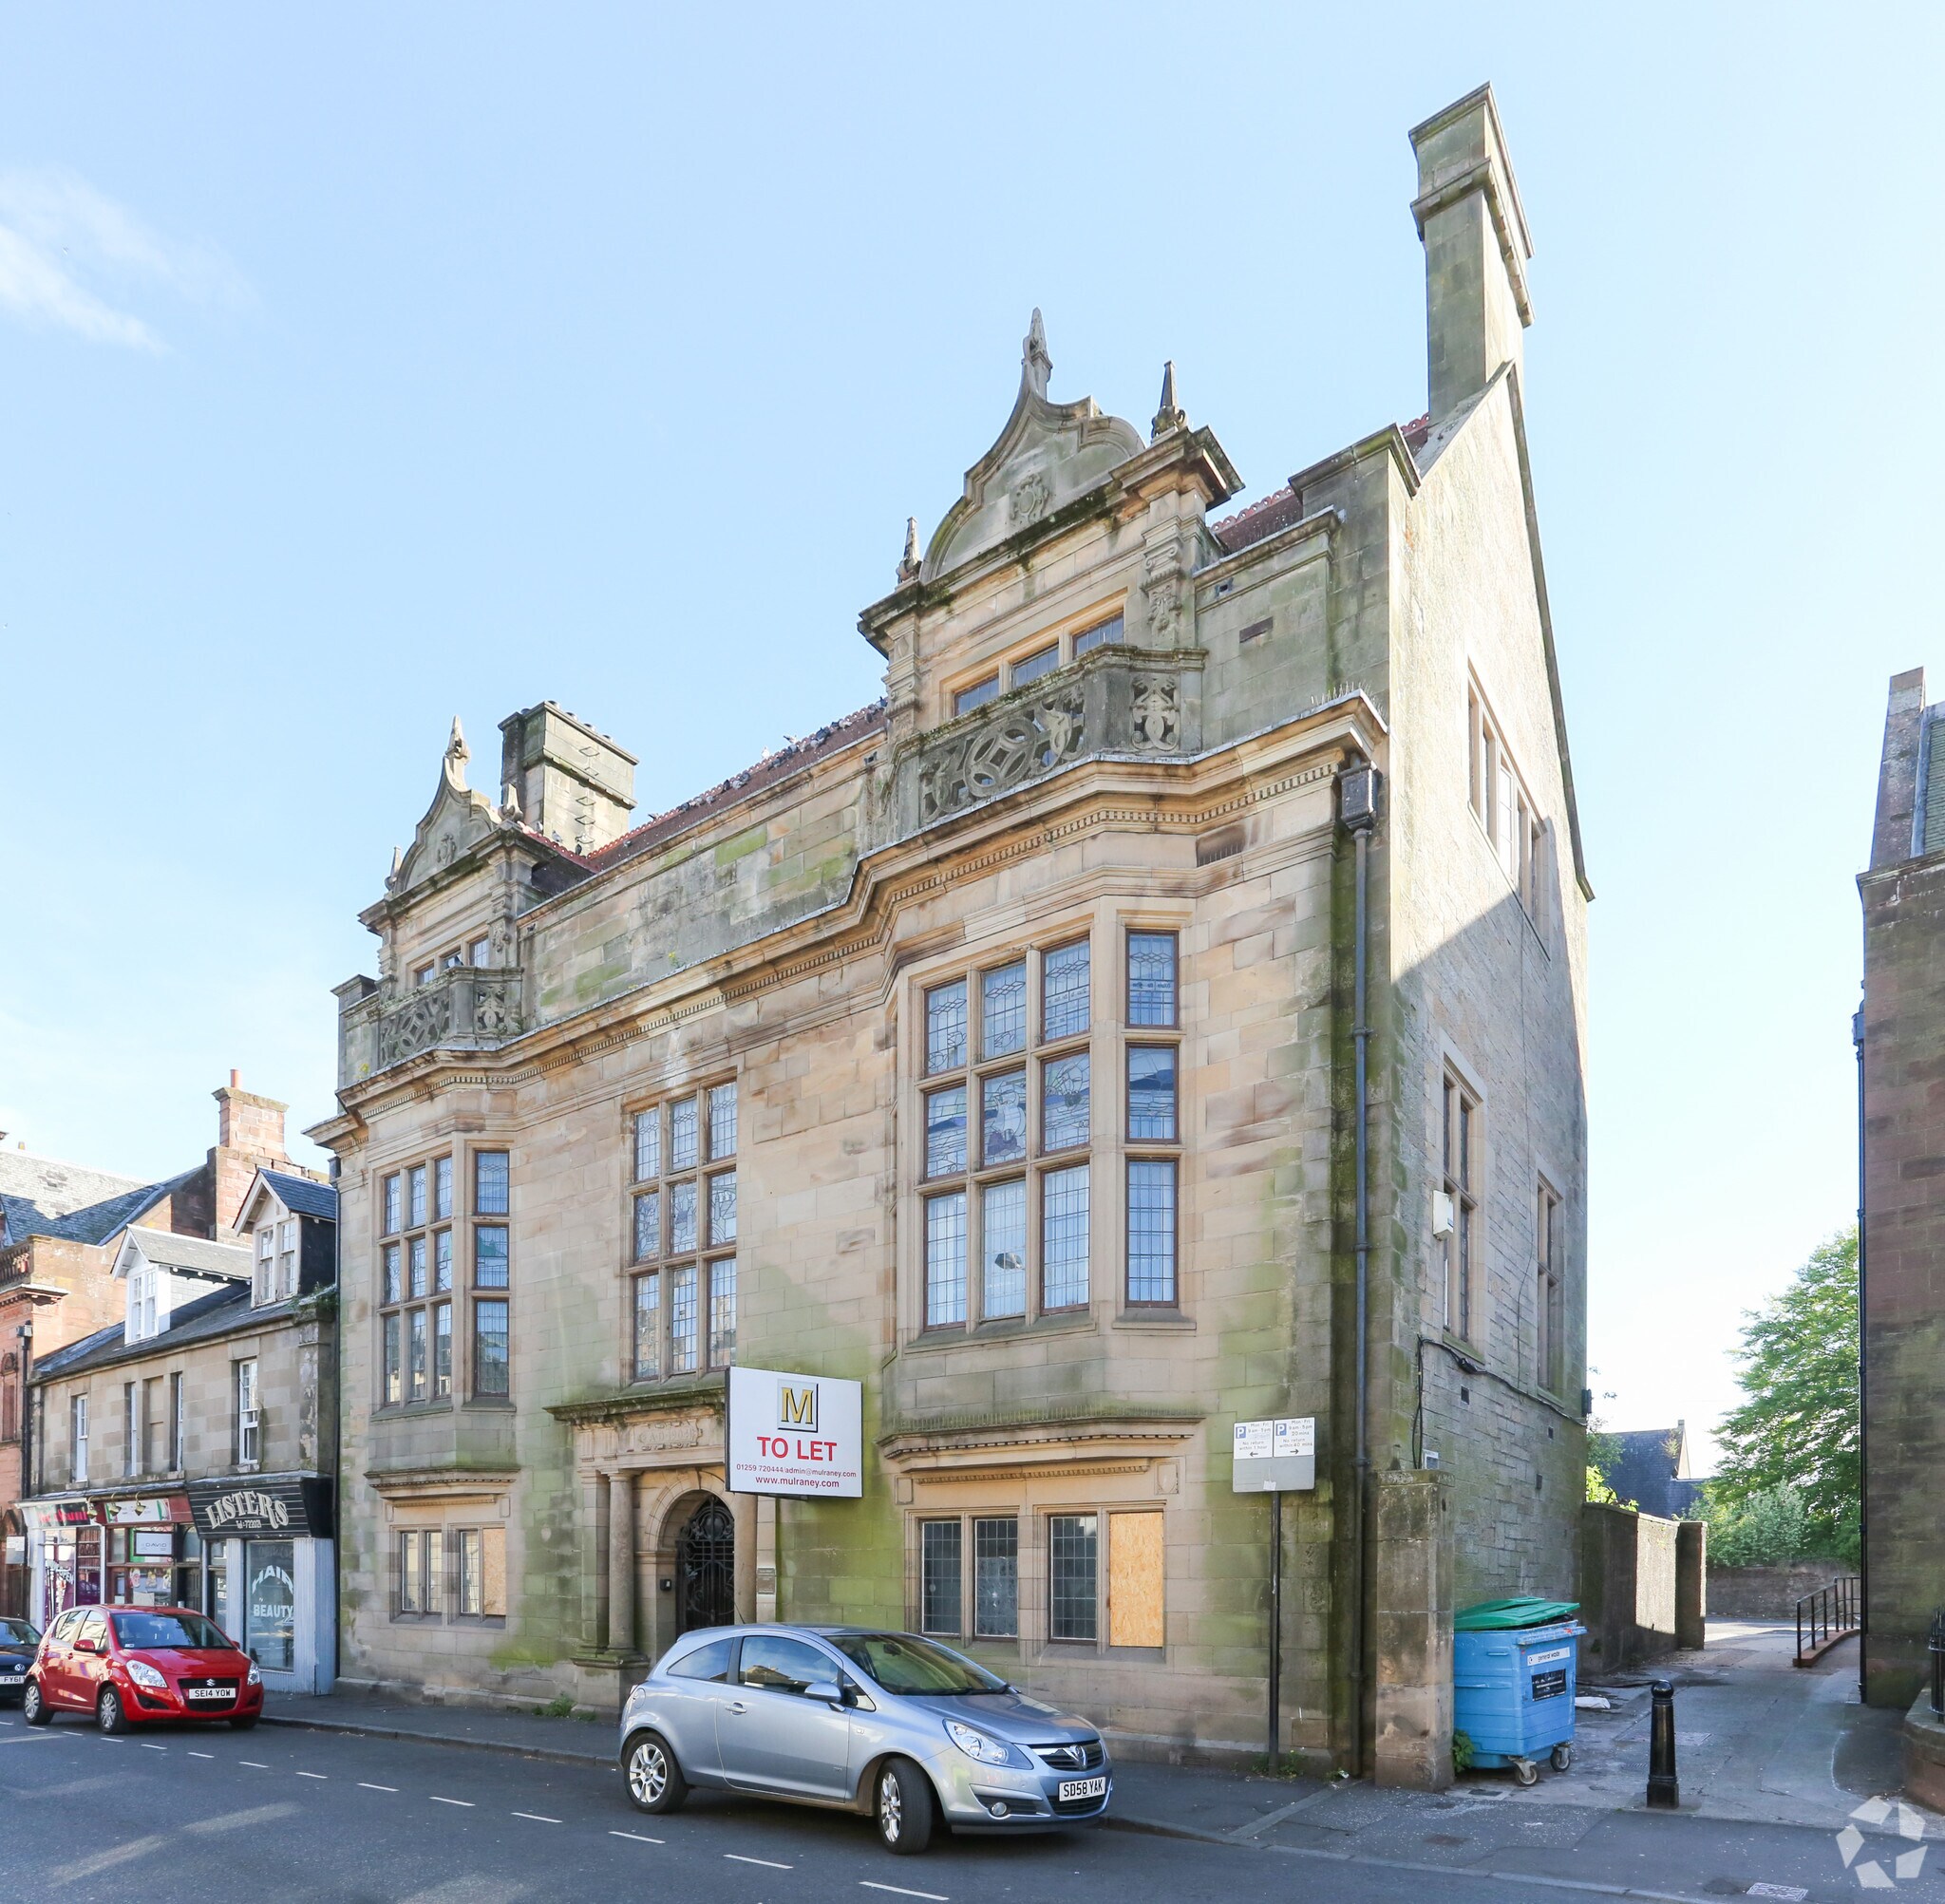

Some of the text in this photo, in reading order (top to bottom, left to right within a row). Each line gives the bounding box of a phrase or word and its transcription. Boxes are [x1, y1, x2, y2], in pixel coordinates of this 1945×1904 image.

[782, 1387, 814, 1424] M
[757, 1436, 838, 1461] TO LET
[736, 1463, 757, 1472] 01259
[755, 1476, 840, 1489] www.mulraney.com
[204, 1490, 290, 1530] LISTERS
[252, 1564, 293, 1595] HAIR
[253, 1604, 293, 1618] BEAUTY
[195, 1688, 231, 1698] SE14 YOW
[1064, 1779, 1103, 1797] SD58 YAK
